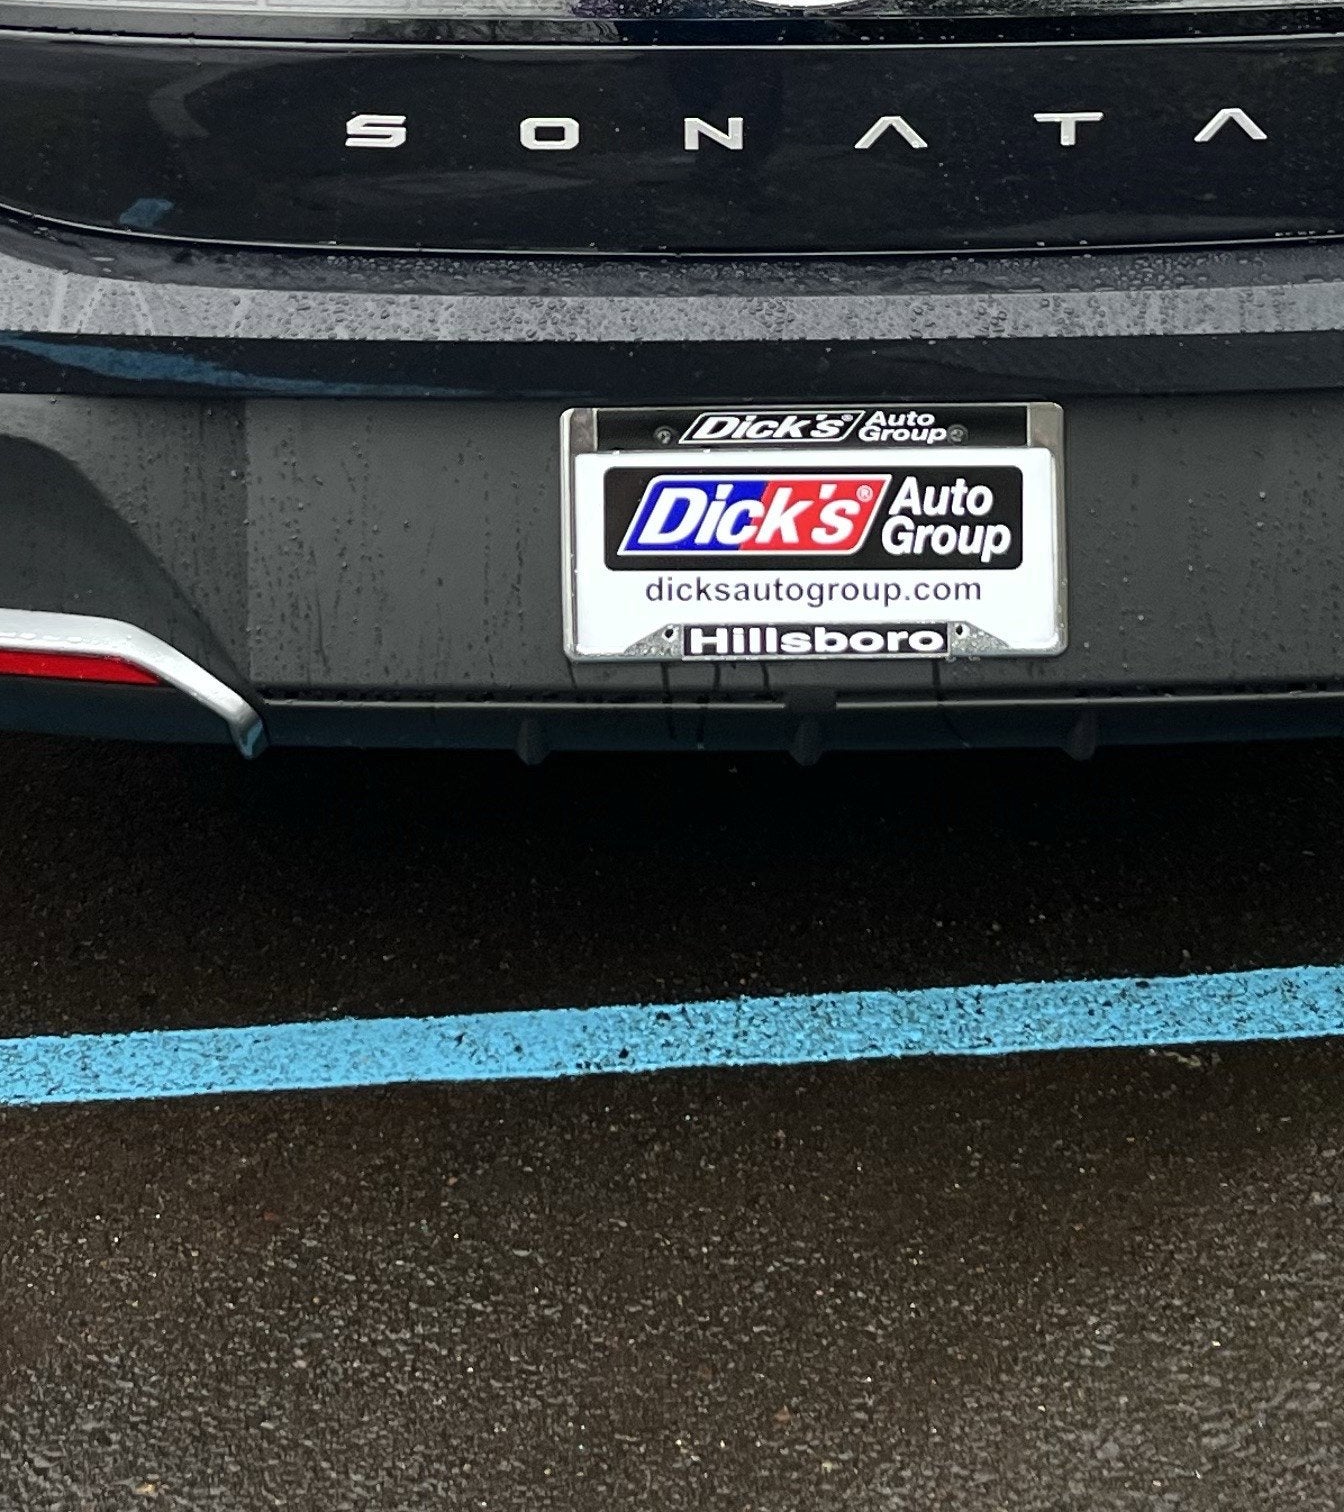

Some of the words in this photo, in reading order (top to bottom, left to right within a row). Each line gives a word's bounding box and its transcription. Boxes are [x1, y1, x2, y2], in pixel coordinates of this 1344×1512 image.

[343, 107, 1268, 150] SONATA
[865, 411, 935, 427] Auto
[858, 425, 947, 444] Group
[888, 476, 993, 516] Auto
[881, 516, 1011, 562] Group
[645, 577, 981, 607] dicksautogroup.com
[690, 627, 944, 655] Hillsboro
